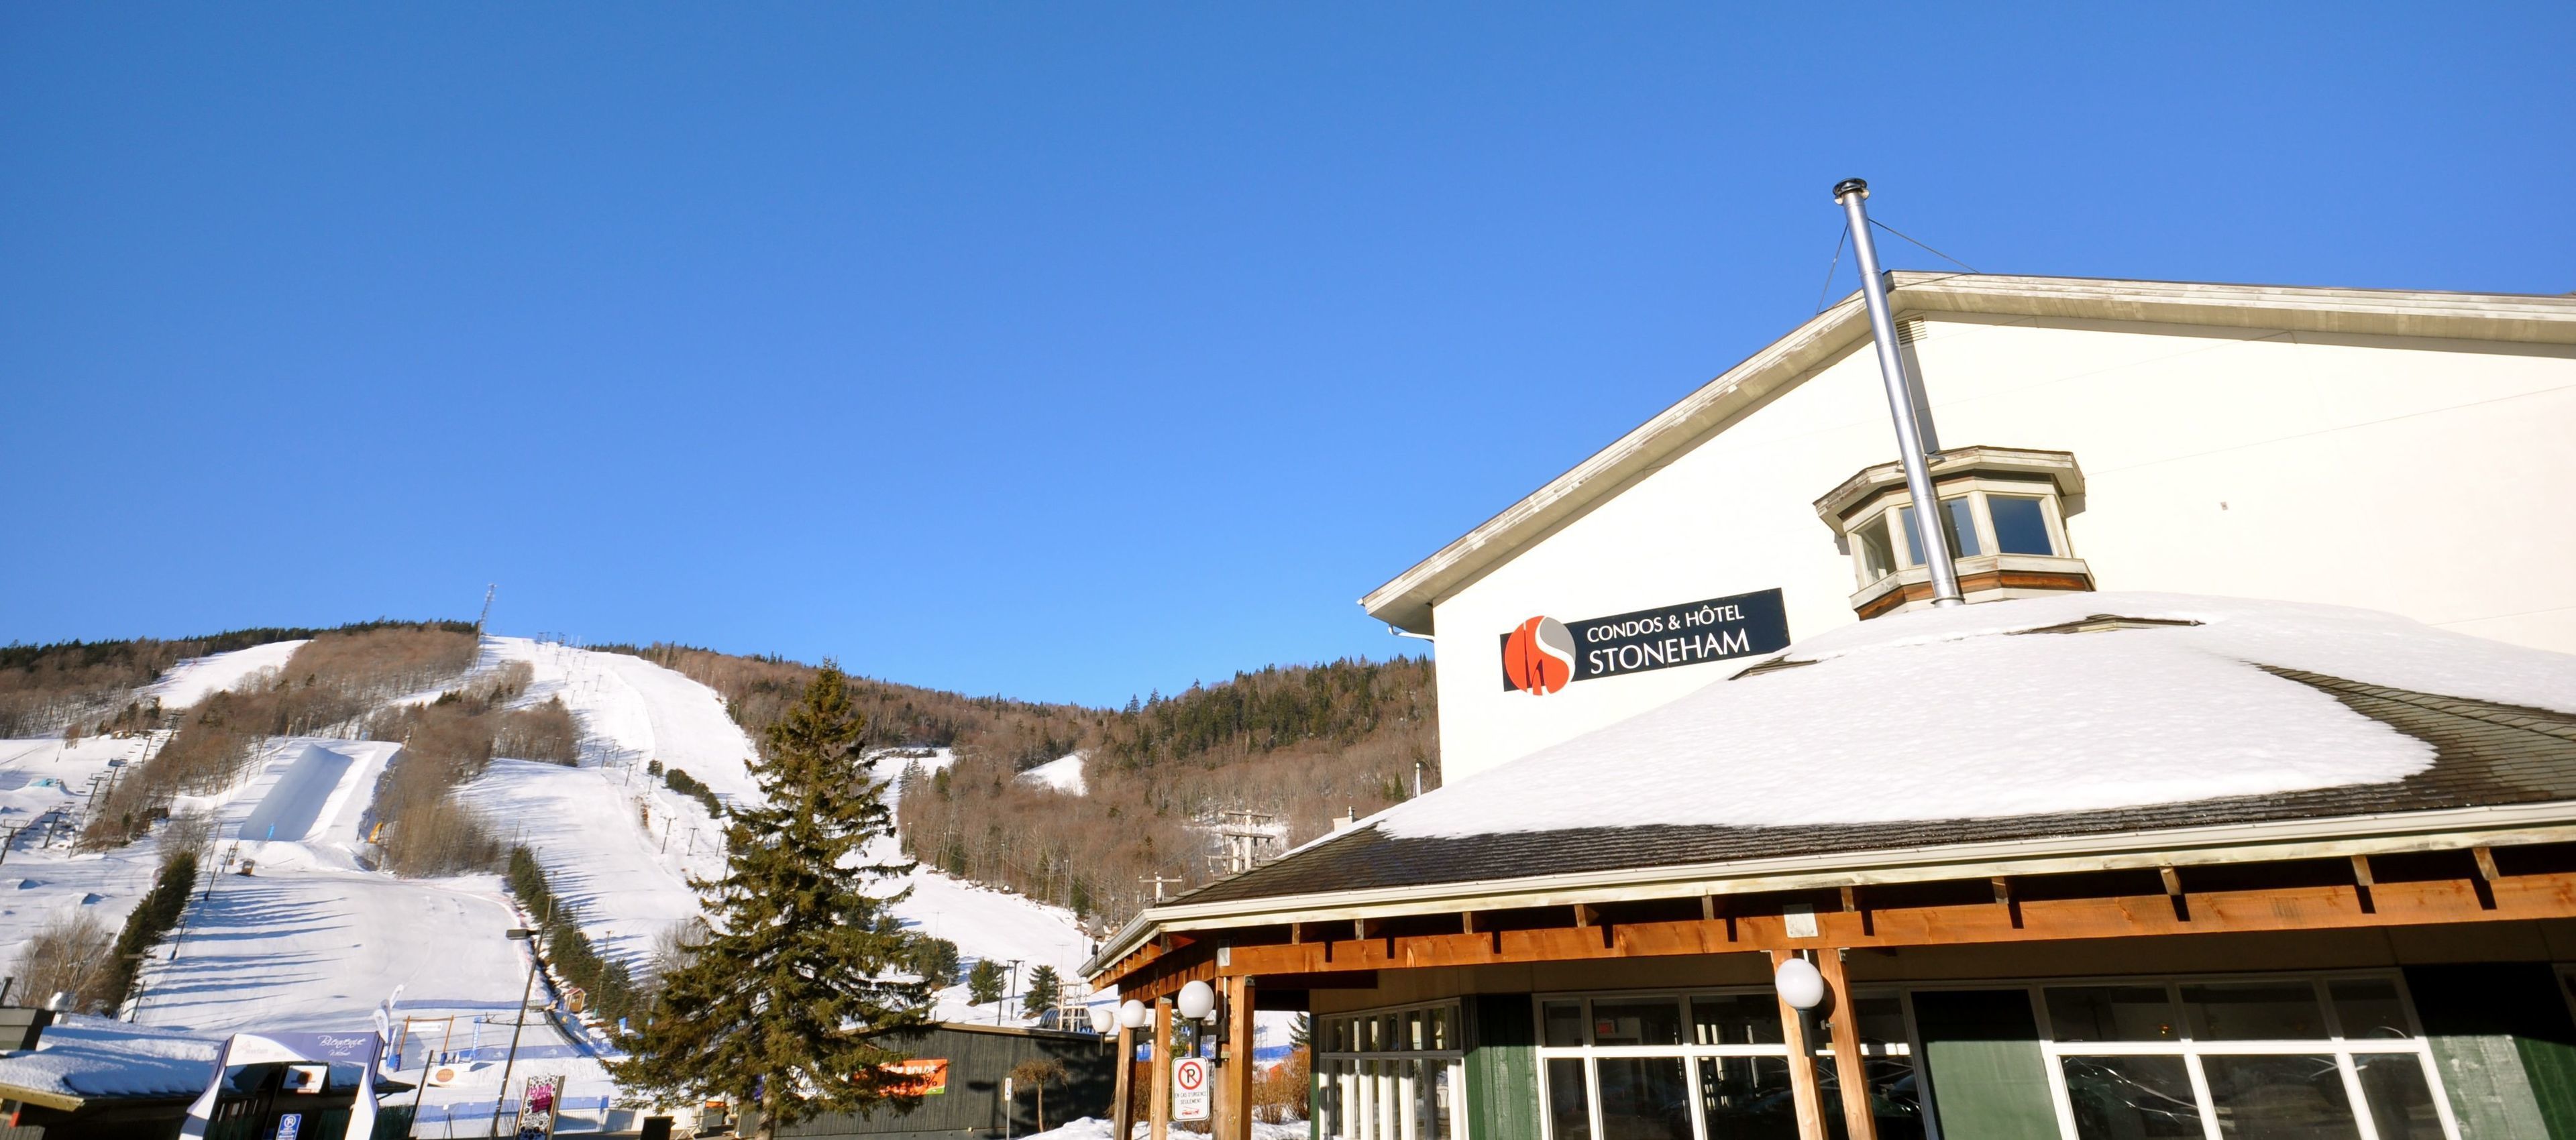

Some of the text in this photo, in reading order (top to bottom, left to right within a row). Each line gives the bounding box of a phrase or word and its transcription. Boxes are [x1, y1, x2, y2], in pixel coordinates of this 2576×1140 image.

[1587, 605, 1745, 642] CONDOS & HÔTEL
[1589, 628, 1750, 674] STONEHAM
